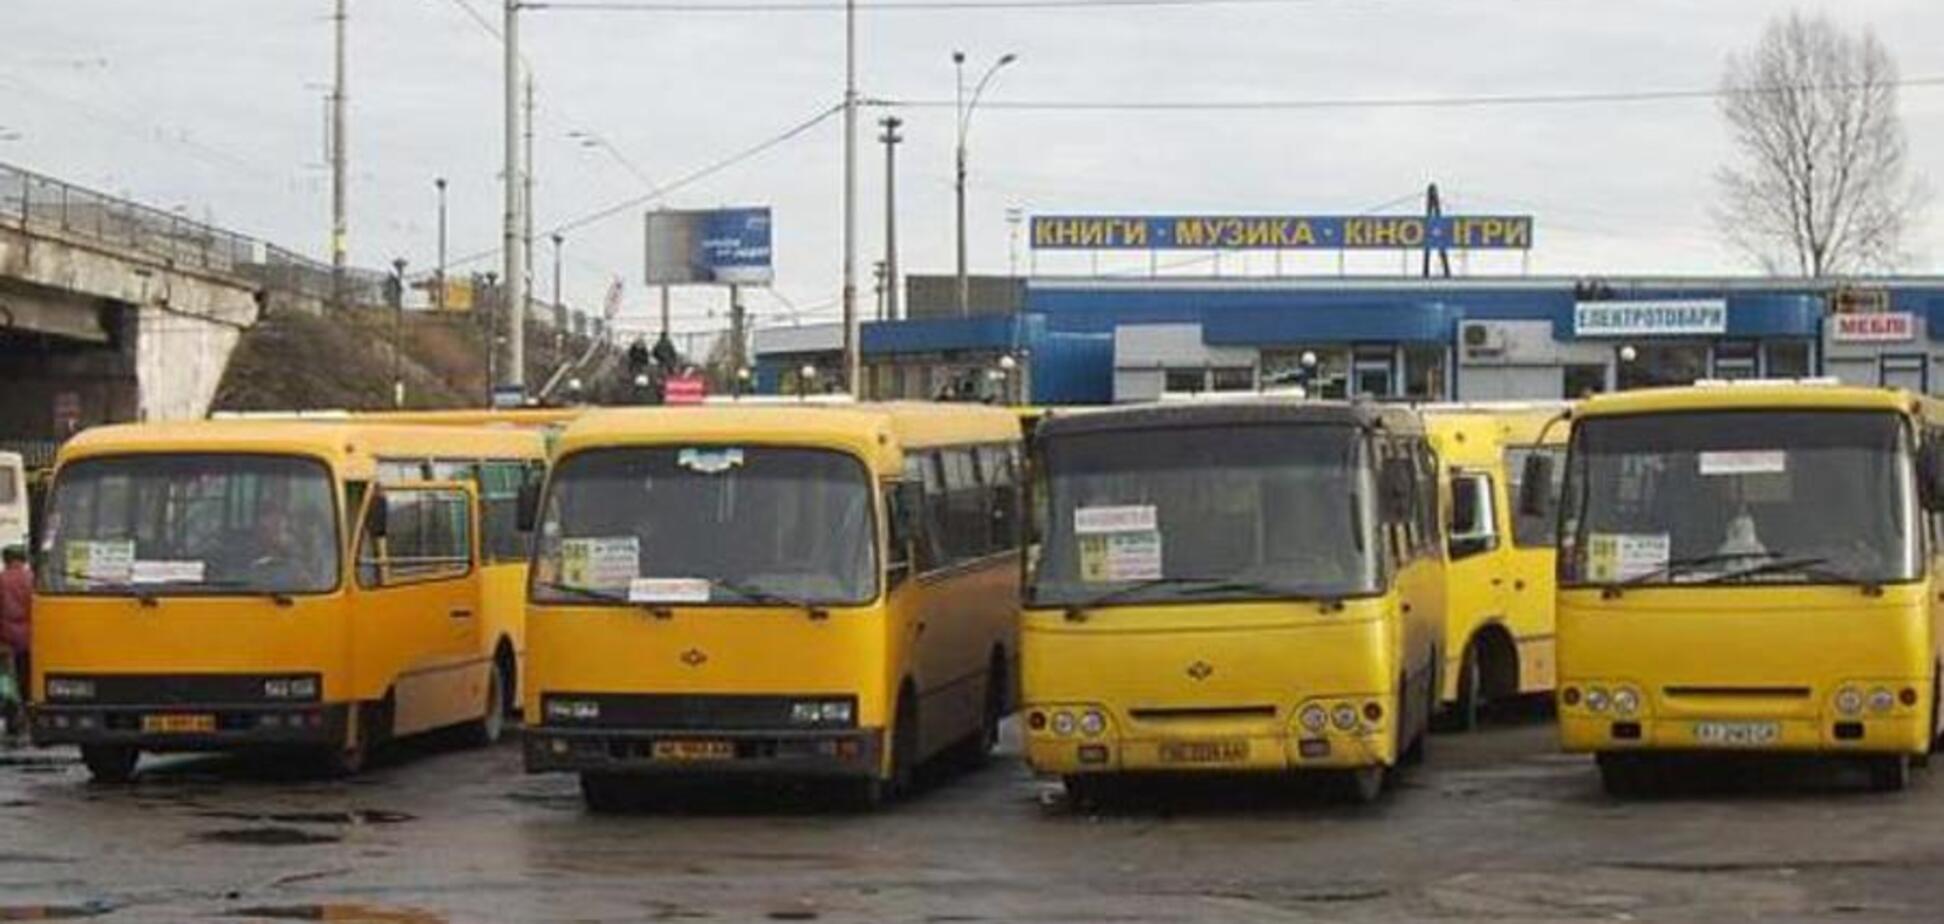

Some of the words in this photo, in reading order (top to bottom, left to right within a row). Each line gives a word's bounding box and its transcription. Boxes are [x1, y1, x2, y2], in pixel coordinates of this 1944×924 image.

[1035, 218, 1147, 245] КНИГИ
[1174, 218, 1316, 245] МУЗИКА
[1343, 219, 1425, 245] КІНО
[1453, 219, 1528, 245] ІГРИ
[1579, 307, 1722, 329] ЕЛЕКТРОТОВАРИ
[1839, 317, 1907, 334] МЕБЛІ
